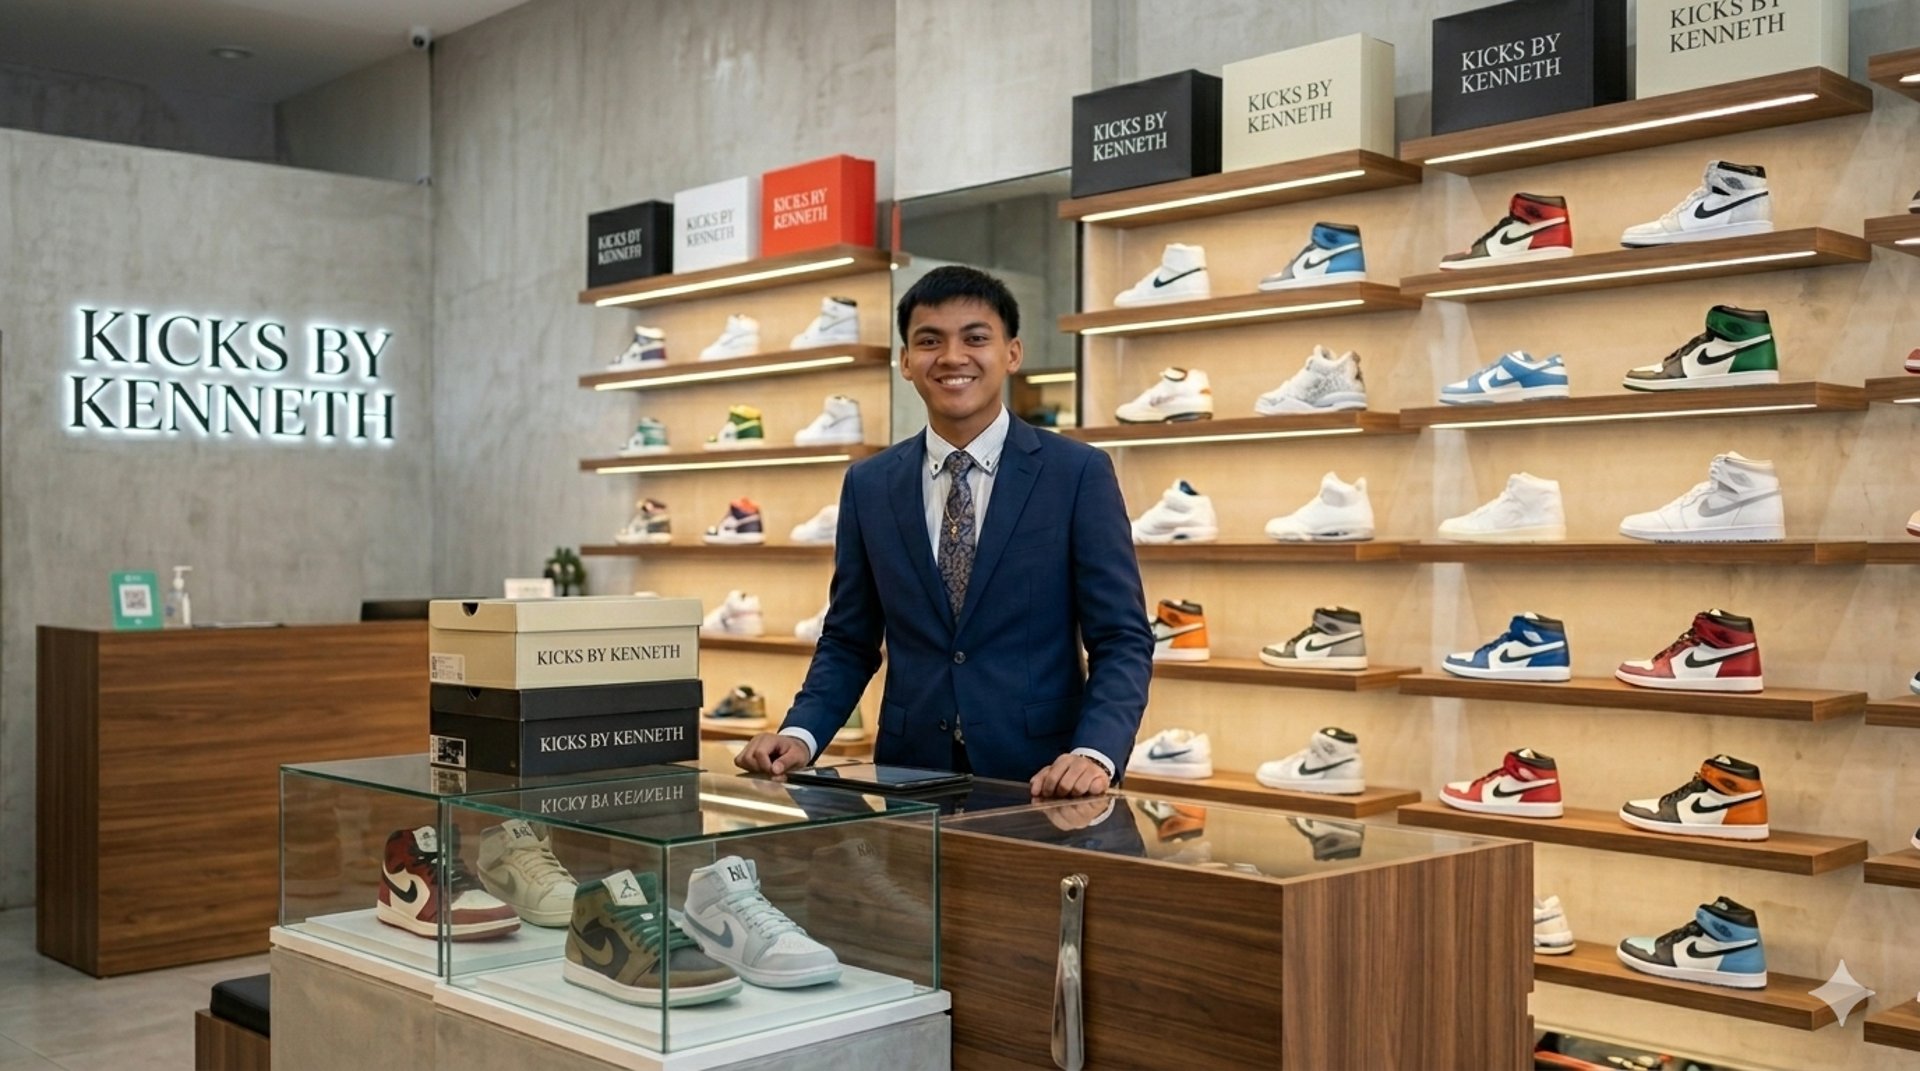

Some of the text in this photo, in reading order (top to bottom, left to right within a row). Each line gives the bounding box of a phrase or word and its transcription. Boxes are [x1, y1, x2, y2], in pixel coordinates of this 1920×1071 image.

[1669, 0, 1744, 28] KICKS
[1670, 12, 1786, 53] KENNETH
[1461, 33, 1562, 71] KICKS BY
[1461, 58, 1562, 94] KENNETH
[1248, 79, 1333, 113] KICKS BY
[1094, 111, 1167, 142] KICKS BY
[1248, 101, 1333, 134] KENNETH
[1094, 132, 1168, 162] KENNETH
[79, 309, 394, 377] KICKS BY
[69, 376, 396, 439] KENNETH
[537, 645, 681, 665] KICKS BY KENNETH
[540, 726, 684, 752] KICKS BY KENNETH
